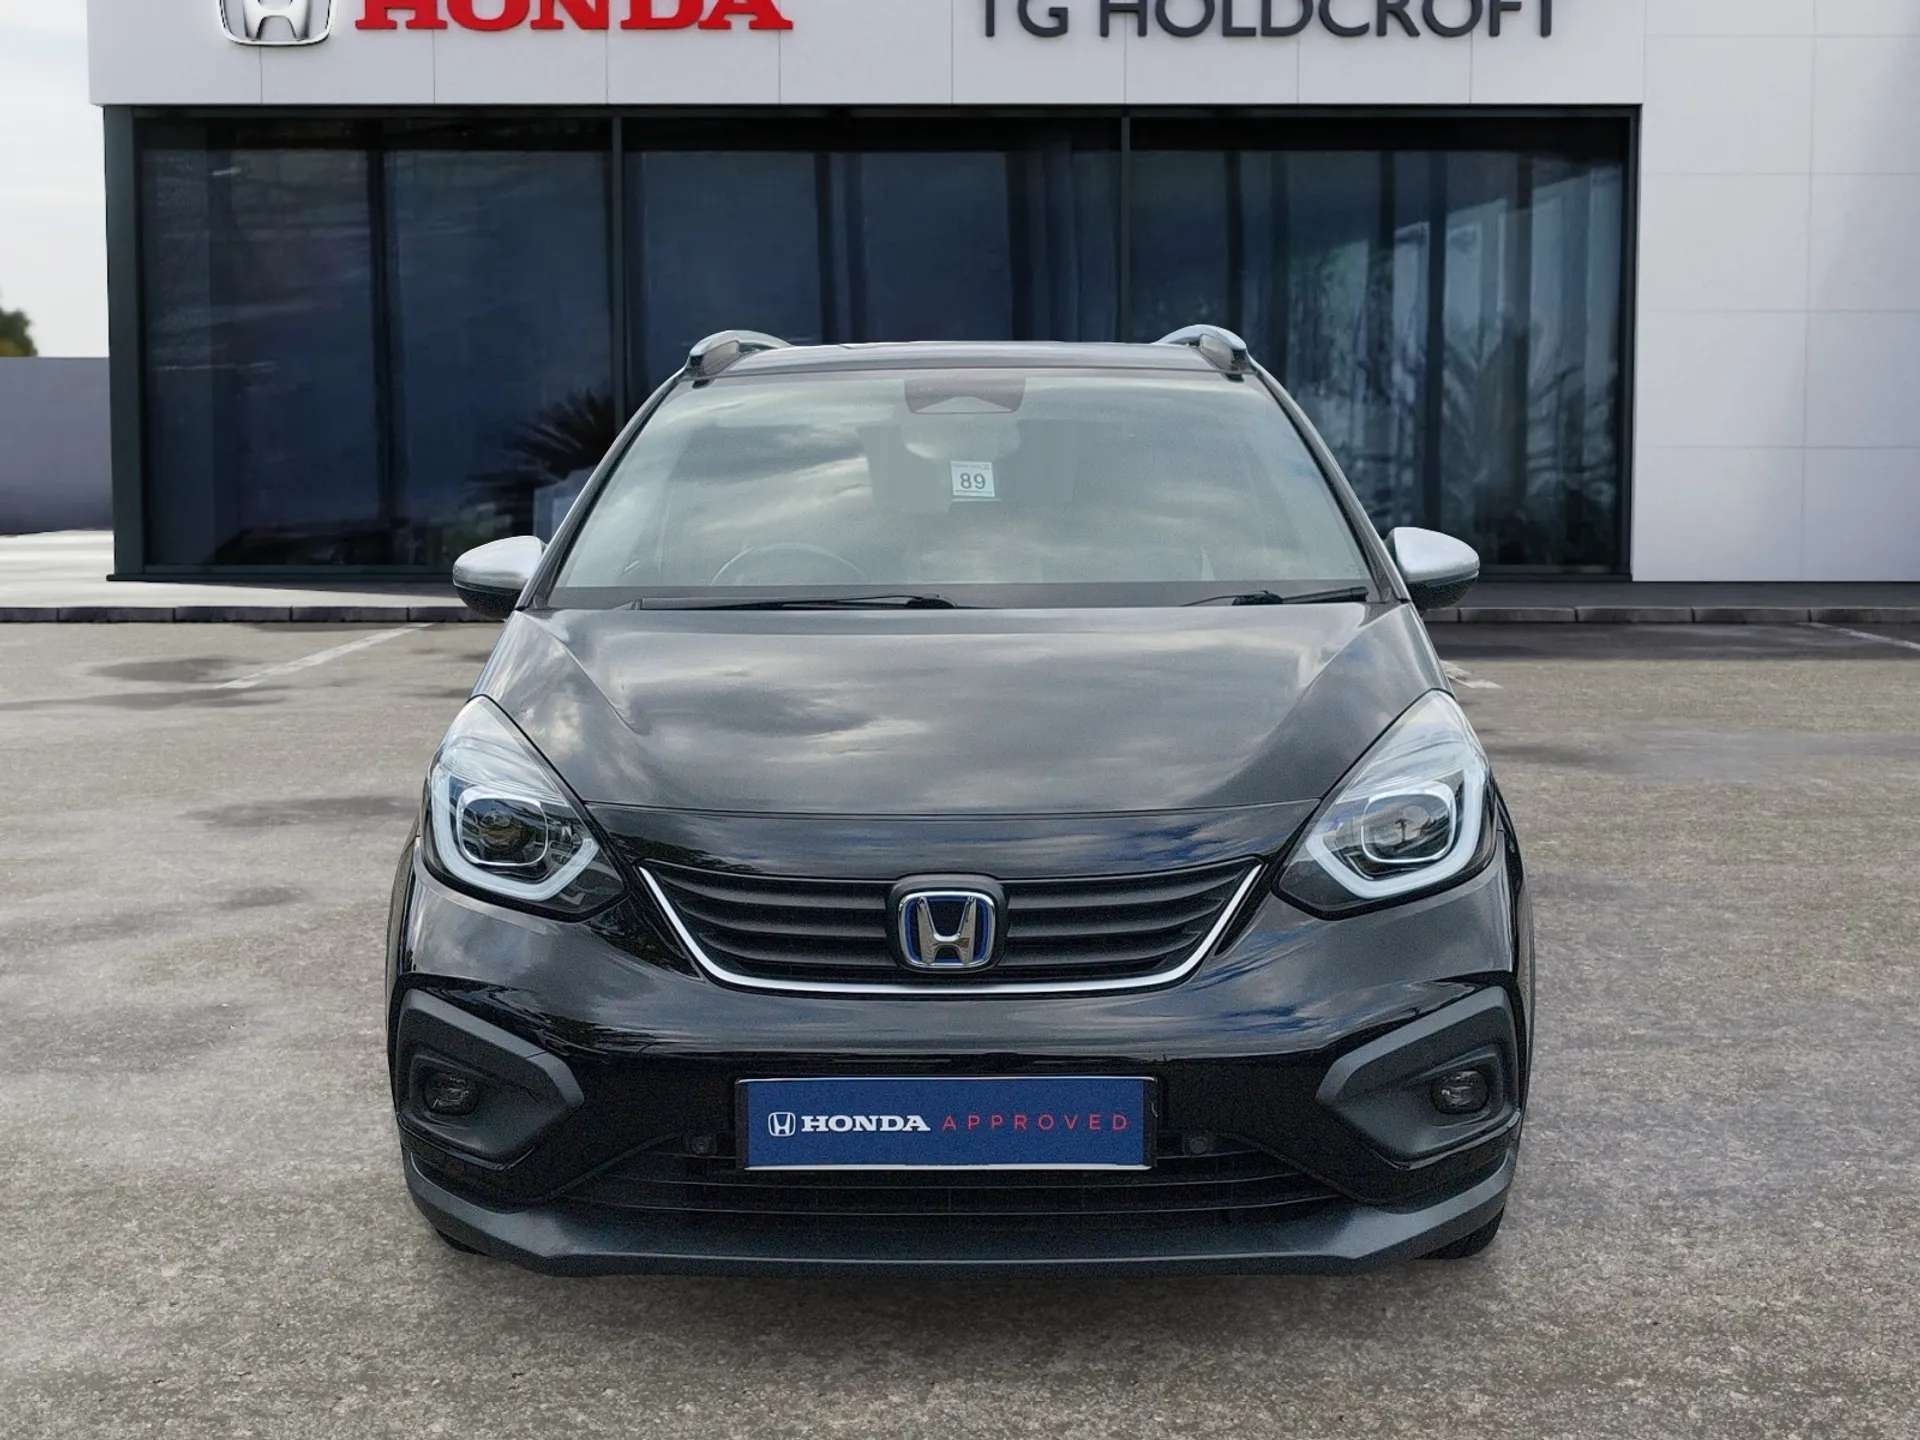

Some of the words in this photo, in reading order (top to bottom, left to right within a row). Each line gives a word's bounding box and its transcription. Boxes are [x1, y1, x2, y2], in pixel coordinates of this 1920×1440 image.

[355, 0, 793, 31] HONDA
[959, 473, 985, 490] 89
[801, 1115, 931, 1132] HONDA
[943, 1113, 1129, 1131] APPROVED
